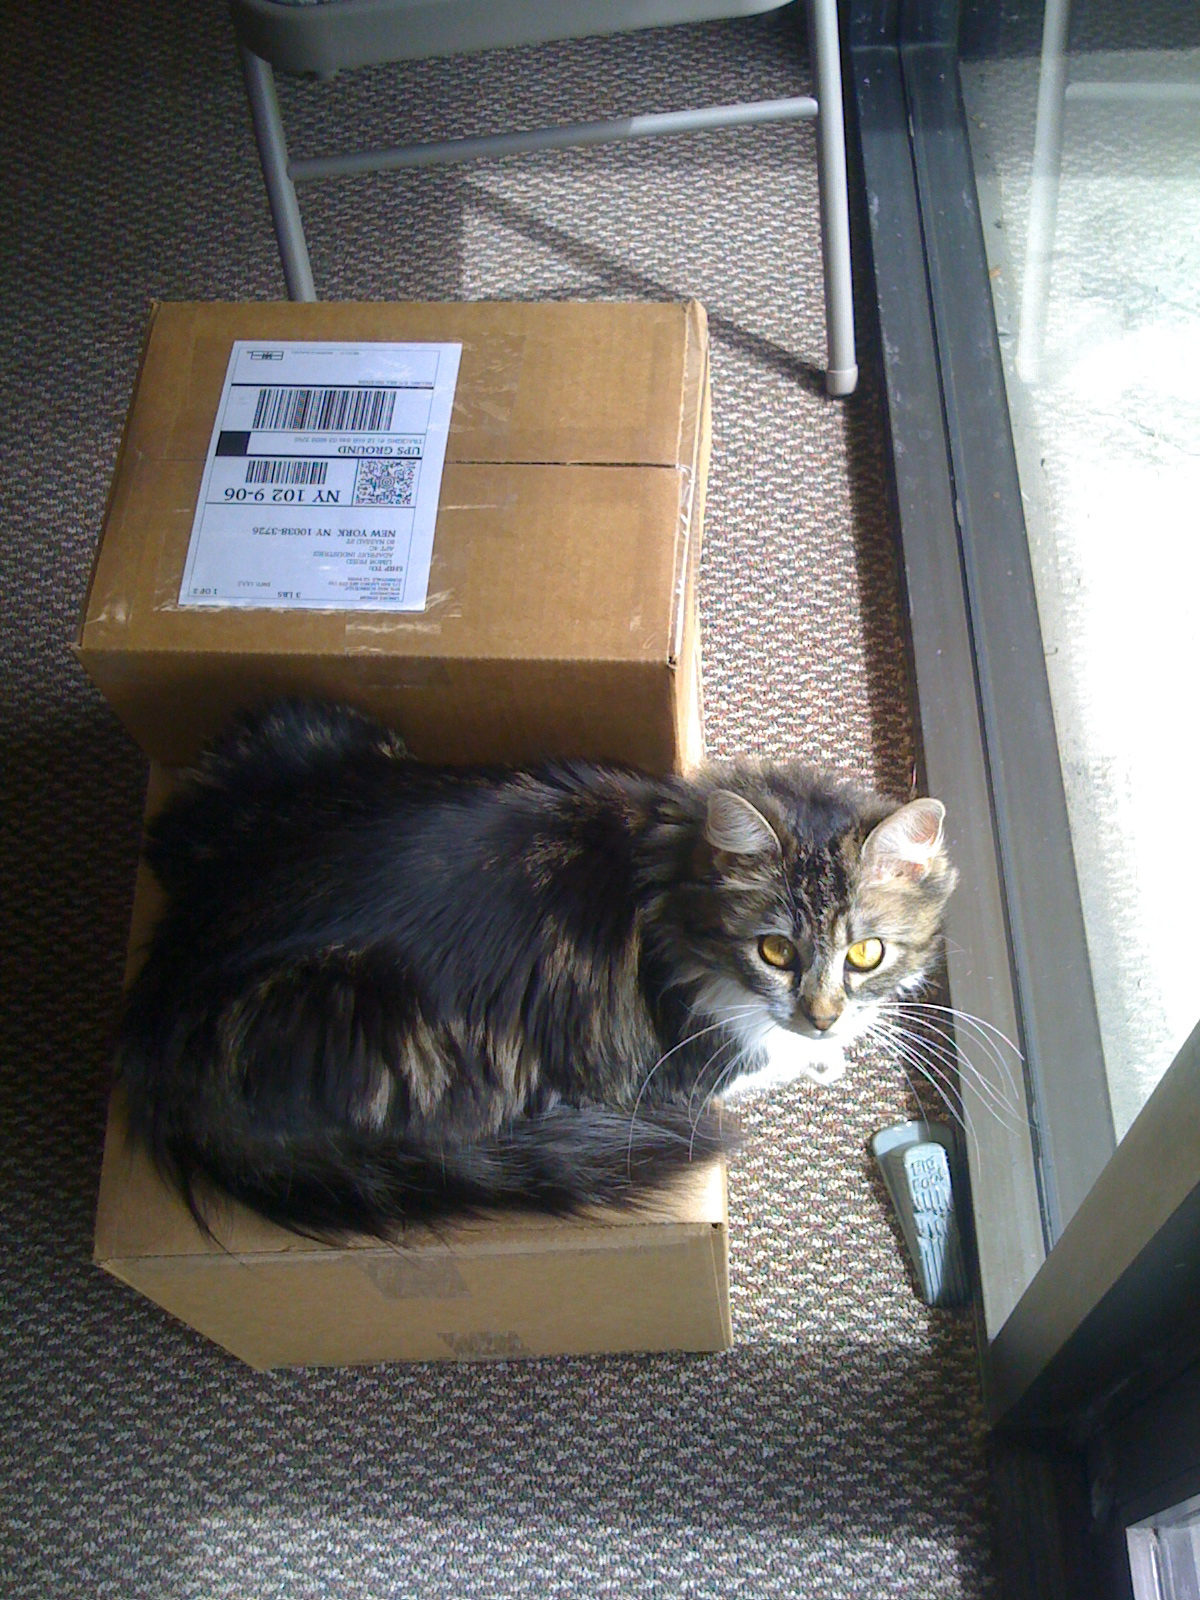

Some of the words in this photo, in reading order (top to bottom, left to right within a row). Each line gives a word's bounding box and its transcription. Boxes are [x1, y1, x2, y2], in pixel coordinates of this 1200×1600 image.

[337, 445, 393, 455] GROUND
[397, 446, 421, 455] UPS
[224, 488, 265, 502] 9-06
[273, 489, 305, 502] 102
[312, 489, 341, 503] NY
[252, 527, 313, 536] 10038-3726
[337, 529, 367, 537] YORK
